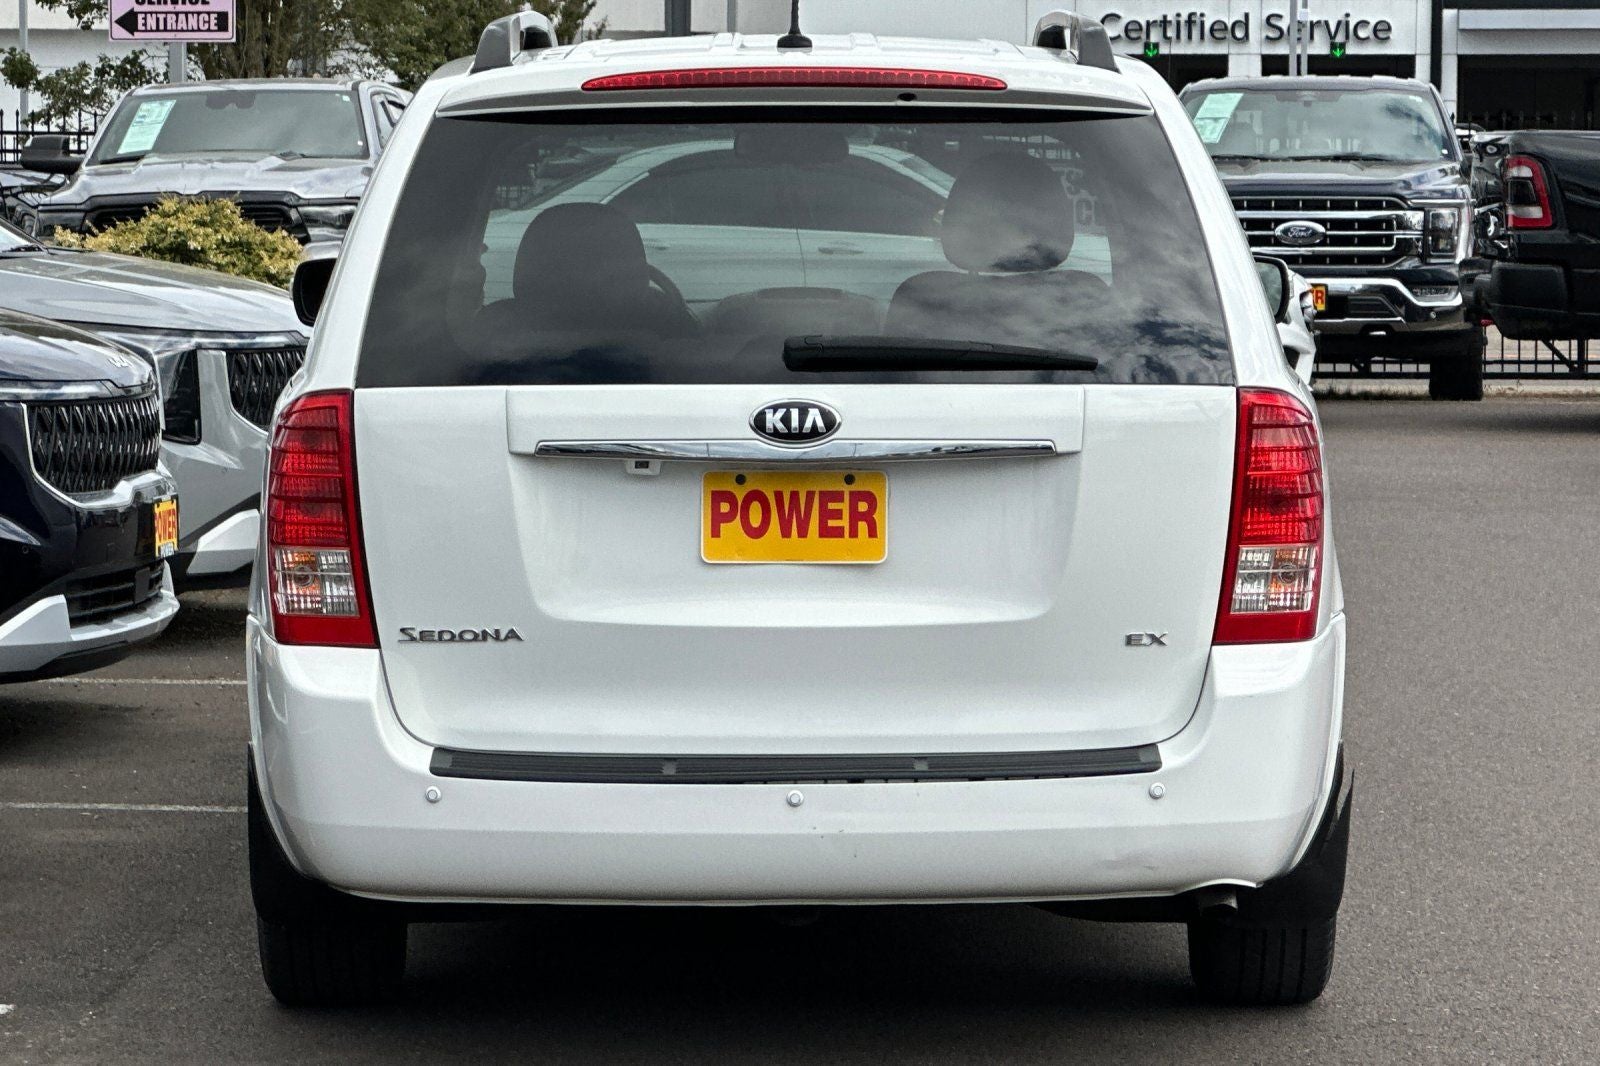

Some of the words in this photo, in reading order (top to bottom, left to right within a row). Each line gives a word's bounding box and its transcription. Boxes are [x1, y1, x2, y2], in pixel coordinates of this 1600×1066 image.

[137, 13, 218, 31] ENTRANCE
[1100, 12, 1250, 41] Certified
[764, 408, 827, 433] KIA
[710, 489, 878, 540] POWER
[1125, 631, 1168, 646] EX
